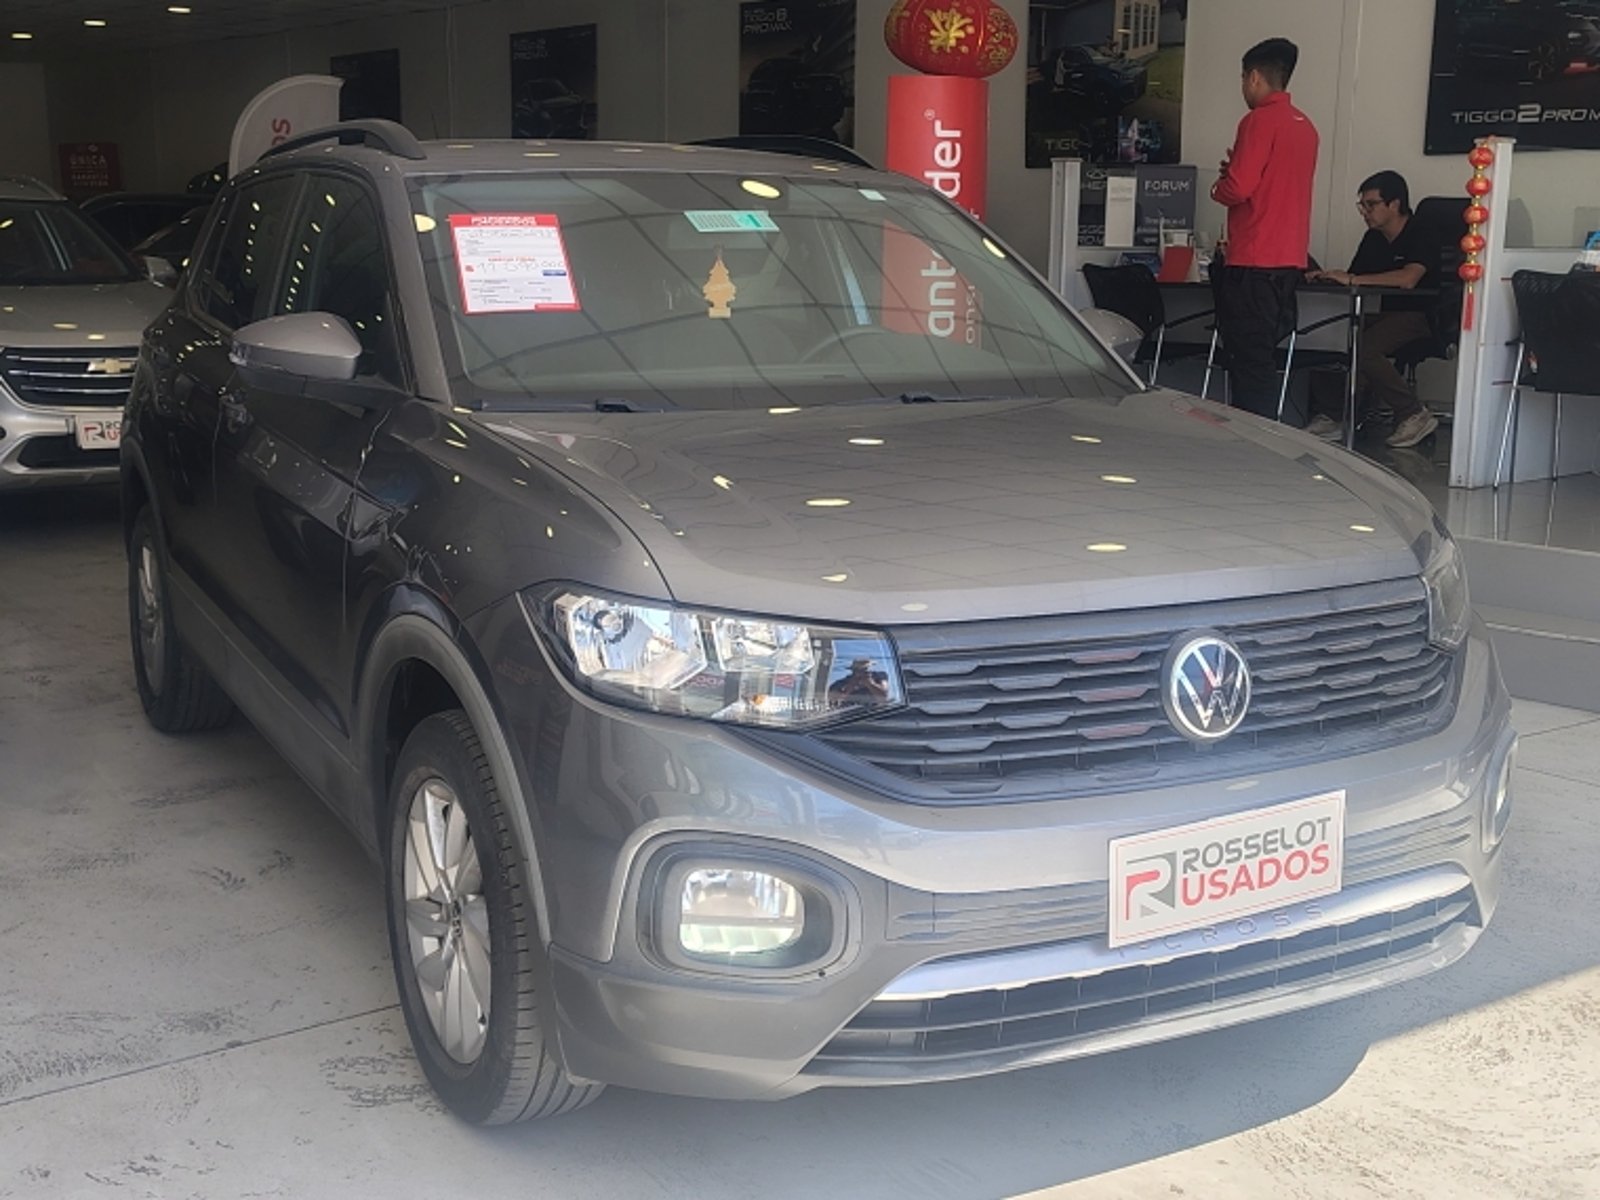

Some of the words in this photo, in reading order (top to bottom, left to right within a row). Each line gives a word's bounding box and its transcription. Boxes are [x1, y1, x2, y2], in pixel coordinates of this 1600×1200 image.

[1451, 108, 1517, 124] TIGGO
[1144, 180, 1190, 192] FORUM
[1182, 816, 1332, 875] ROSSELOT
[1182, 844, 1330, 906] USADOS
